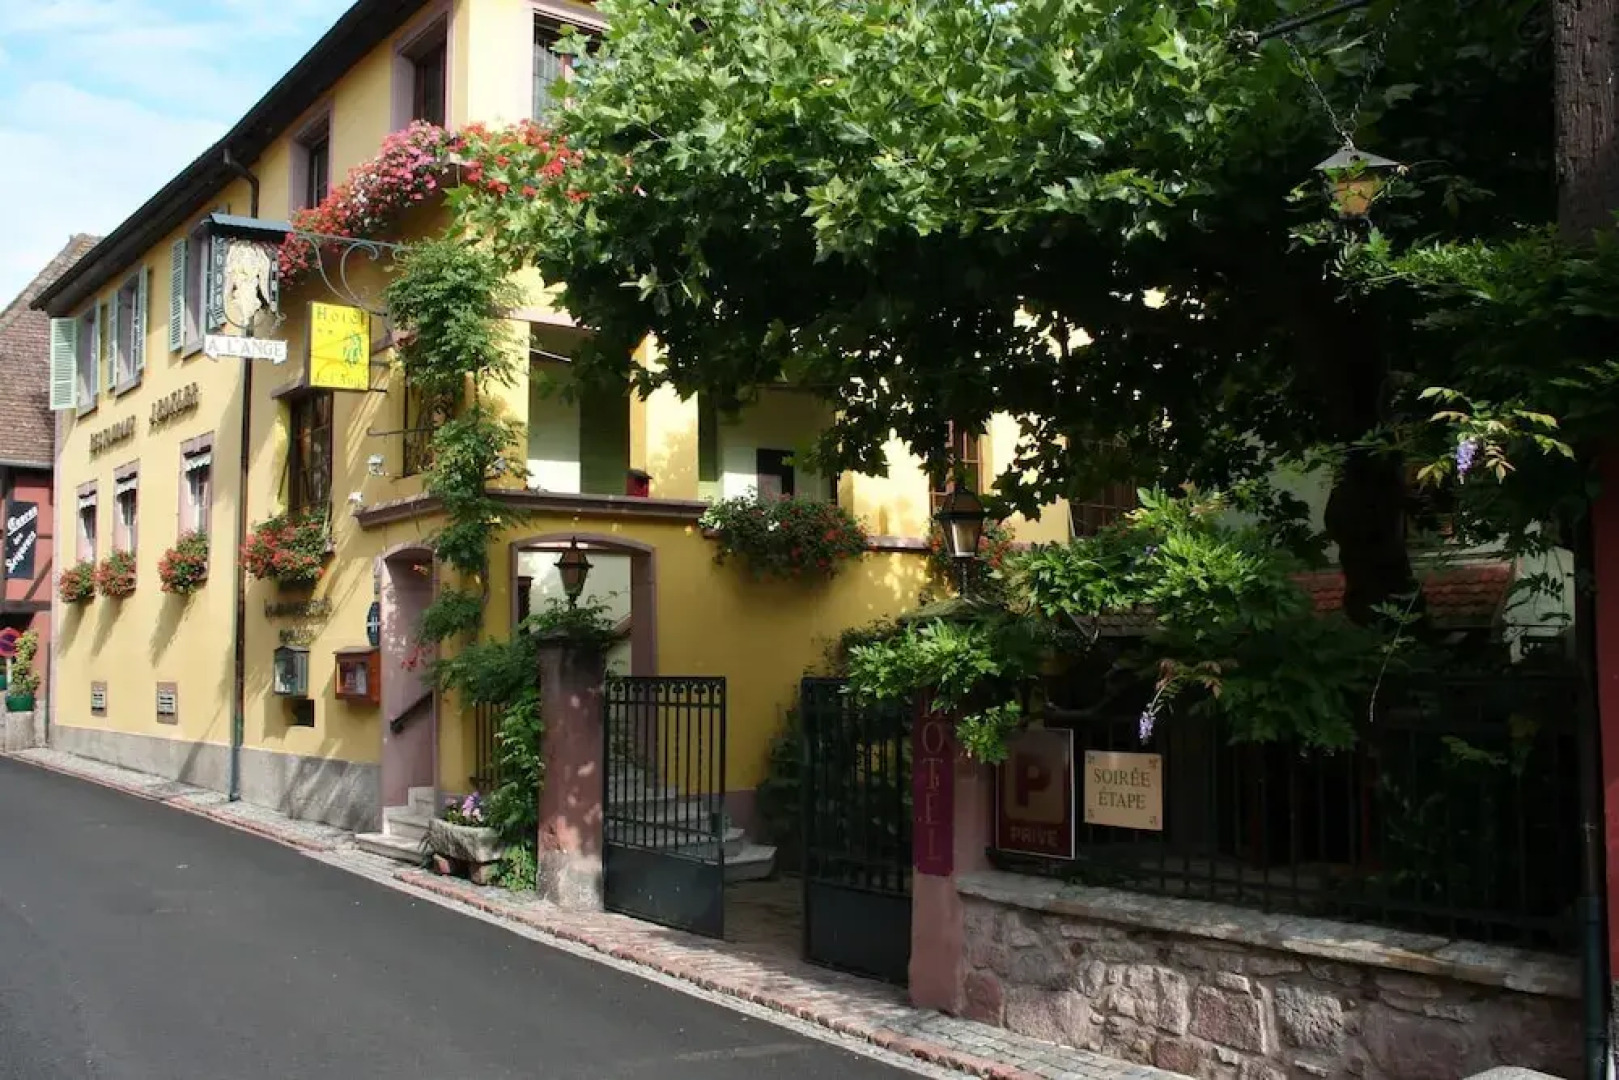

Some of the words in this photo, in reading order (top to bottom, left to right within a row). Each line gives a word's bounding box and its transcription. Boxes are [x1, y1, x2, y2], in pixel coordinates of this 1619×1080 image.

[228, 339, 285, 357] L'ANGE
[1016, 753, 1051, 808] P
[1094, 766, 1151, 788] SOIRÉE
[1099, 785, 1146, 810] ÉTAPE
